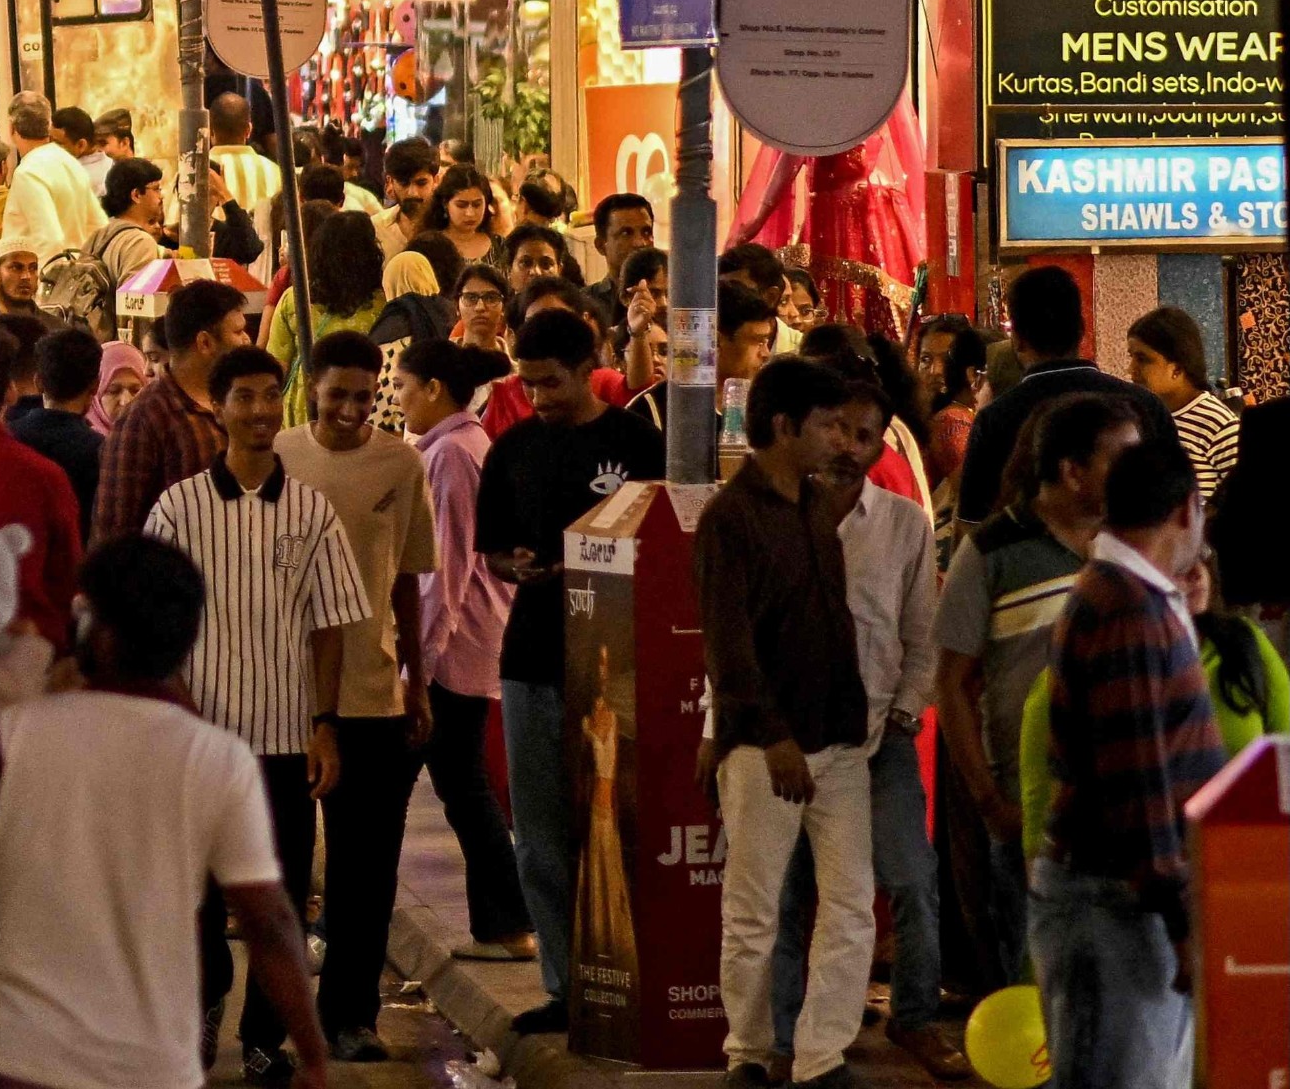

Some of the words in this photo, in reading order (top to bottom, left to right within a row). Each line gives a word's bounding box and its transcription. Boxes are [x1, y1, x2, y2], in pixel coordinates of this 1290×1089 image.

[739, 24, 760, 32] Shop
[1061, 31, 1167, 61] MENS
[750, 68, 771, 76] Shop
[998, 71, 1147, 95] Kurtas,Bandi
[1151, 71, 1284, 95] sets,Indo-w
[1018, 158, 1196, 195] KASHMIR
[1208, 157, 1284, 192] PAS
[1081, 202, 1198, 231] SHAWLS
[1208, 202, 1228, 228] &
[1237, 202, 1290, 229] STO
[567, 578, 596, 620] soch
[656, 824, 729, 866] JEA
[579, 964, 597, 982] THE
[597, 966, 632, 989] FESTIVE
[583, 987, 627, 1008] COLLECTION
[668, 1007, 727, 1021] COMMER
